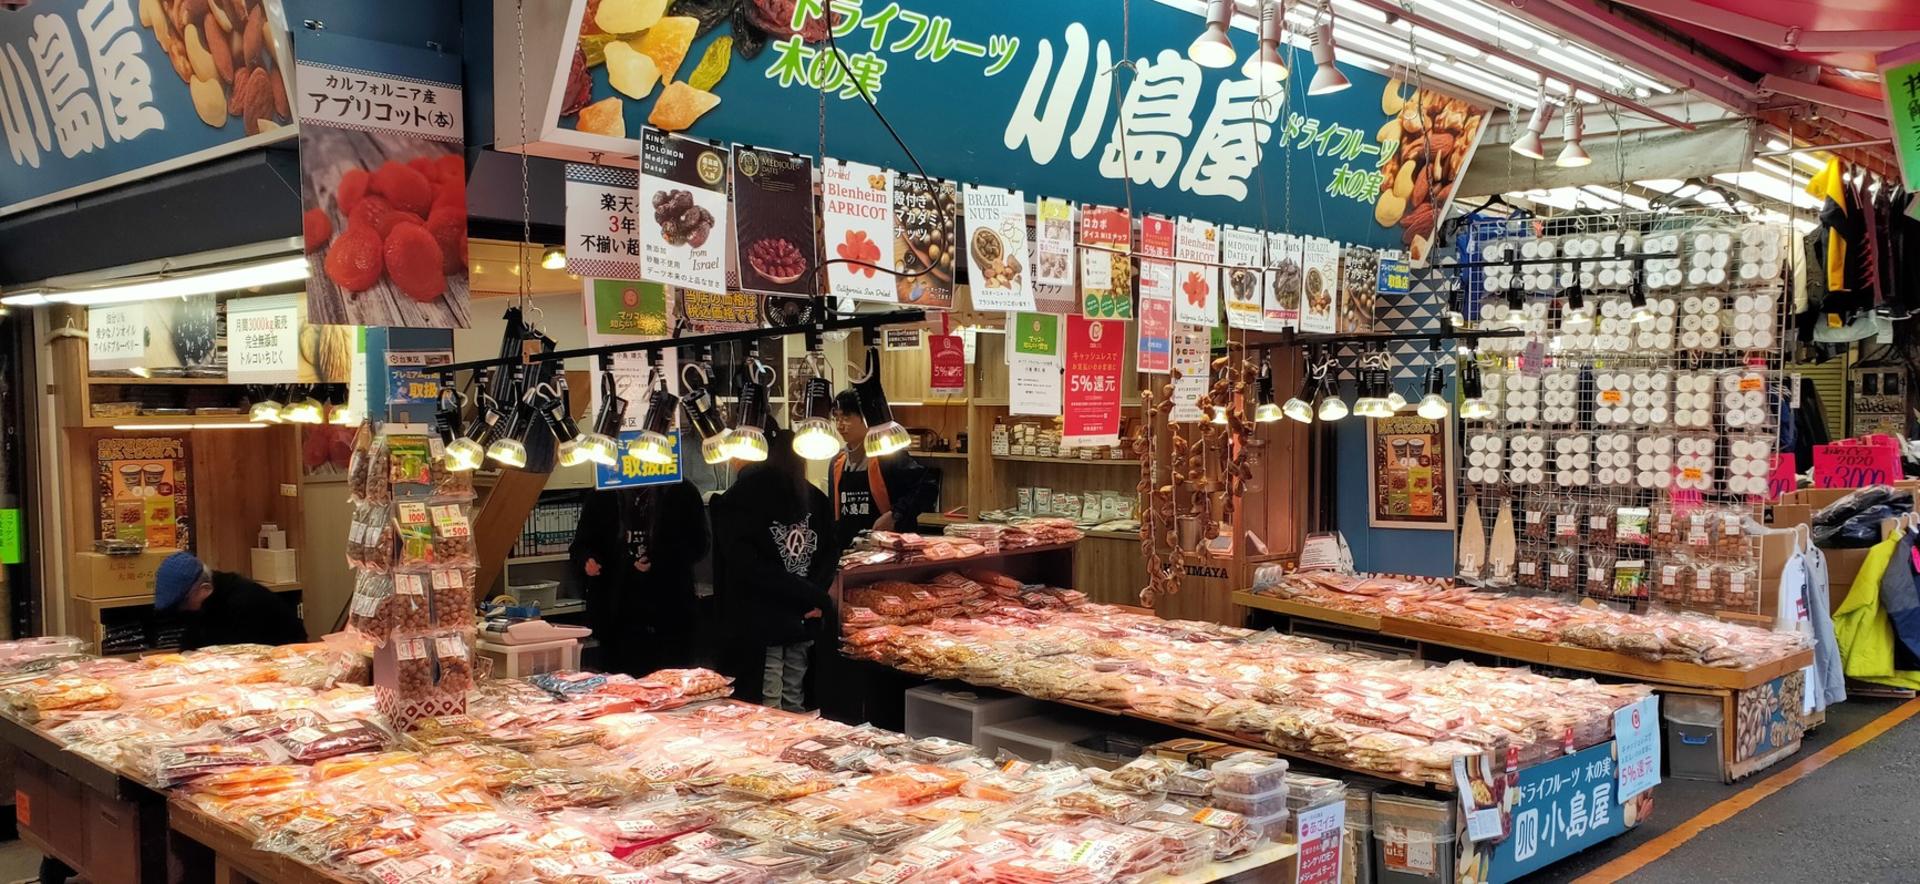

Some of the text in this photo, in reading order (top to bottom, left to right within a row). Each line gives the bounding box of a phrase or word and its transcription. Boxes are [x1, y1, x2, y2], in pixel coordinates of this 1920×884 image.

[790, 0, 1019, 75] ドライフルーツ
[765, 34, 887, 103] 木の実
[326, 75, 437, 105] カルフォルニア産
[1003, 22, 1284, 201] 小島屋
[1280, 112, 1399, 167] ドライフルーツ
[645, 143, 684, 159] SOLOMON
[828, 183, 887, 204] Blenheim
[1325, 163, 1385, 205] 木の実
[600, 193, 639, 214] 楽天
[894, 190, 927, 208] 殻付き
[968, 193, 1009, 207] BRAZIL
[828, 200, 887, 220] APRICOT
[969, 207, 1000, 220] NUTS
[894, 226, 928, 241] ナッツ
[1083, 219, 1108, 229] ロカボ
[689, 248, 707, 260] from
[693, 257, 720, 271] Israel
[240, 350, 284, 365] トルコいちじく
[1071, 375, 1115, 392] 5%還元
[1837, 455, 1874, 466] 2020
[452, 527, 468, 536] 500
[1621, 756, 1654, 786] 5%還元
[1518, 758, 1611, 807] ドライフルーツ 木の実
[1541, 782, 1611, 847] 小島屋
